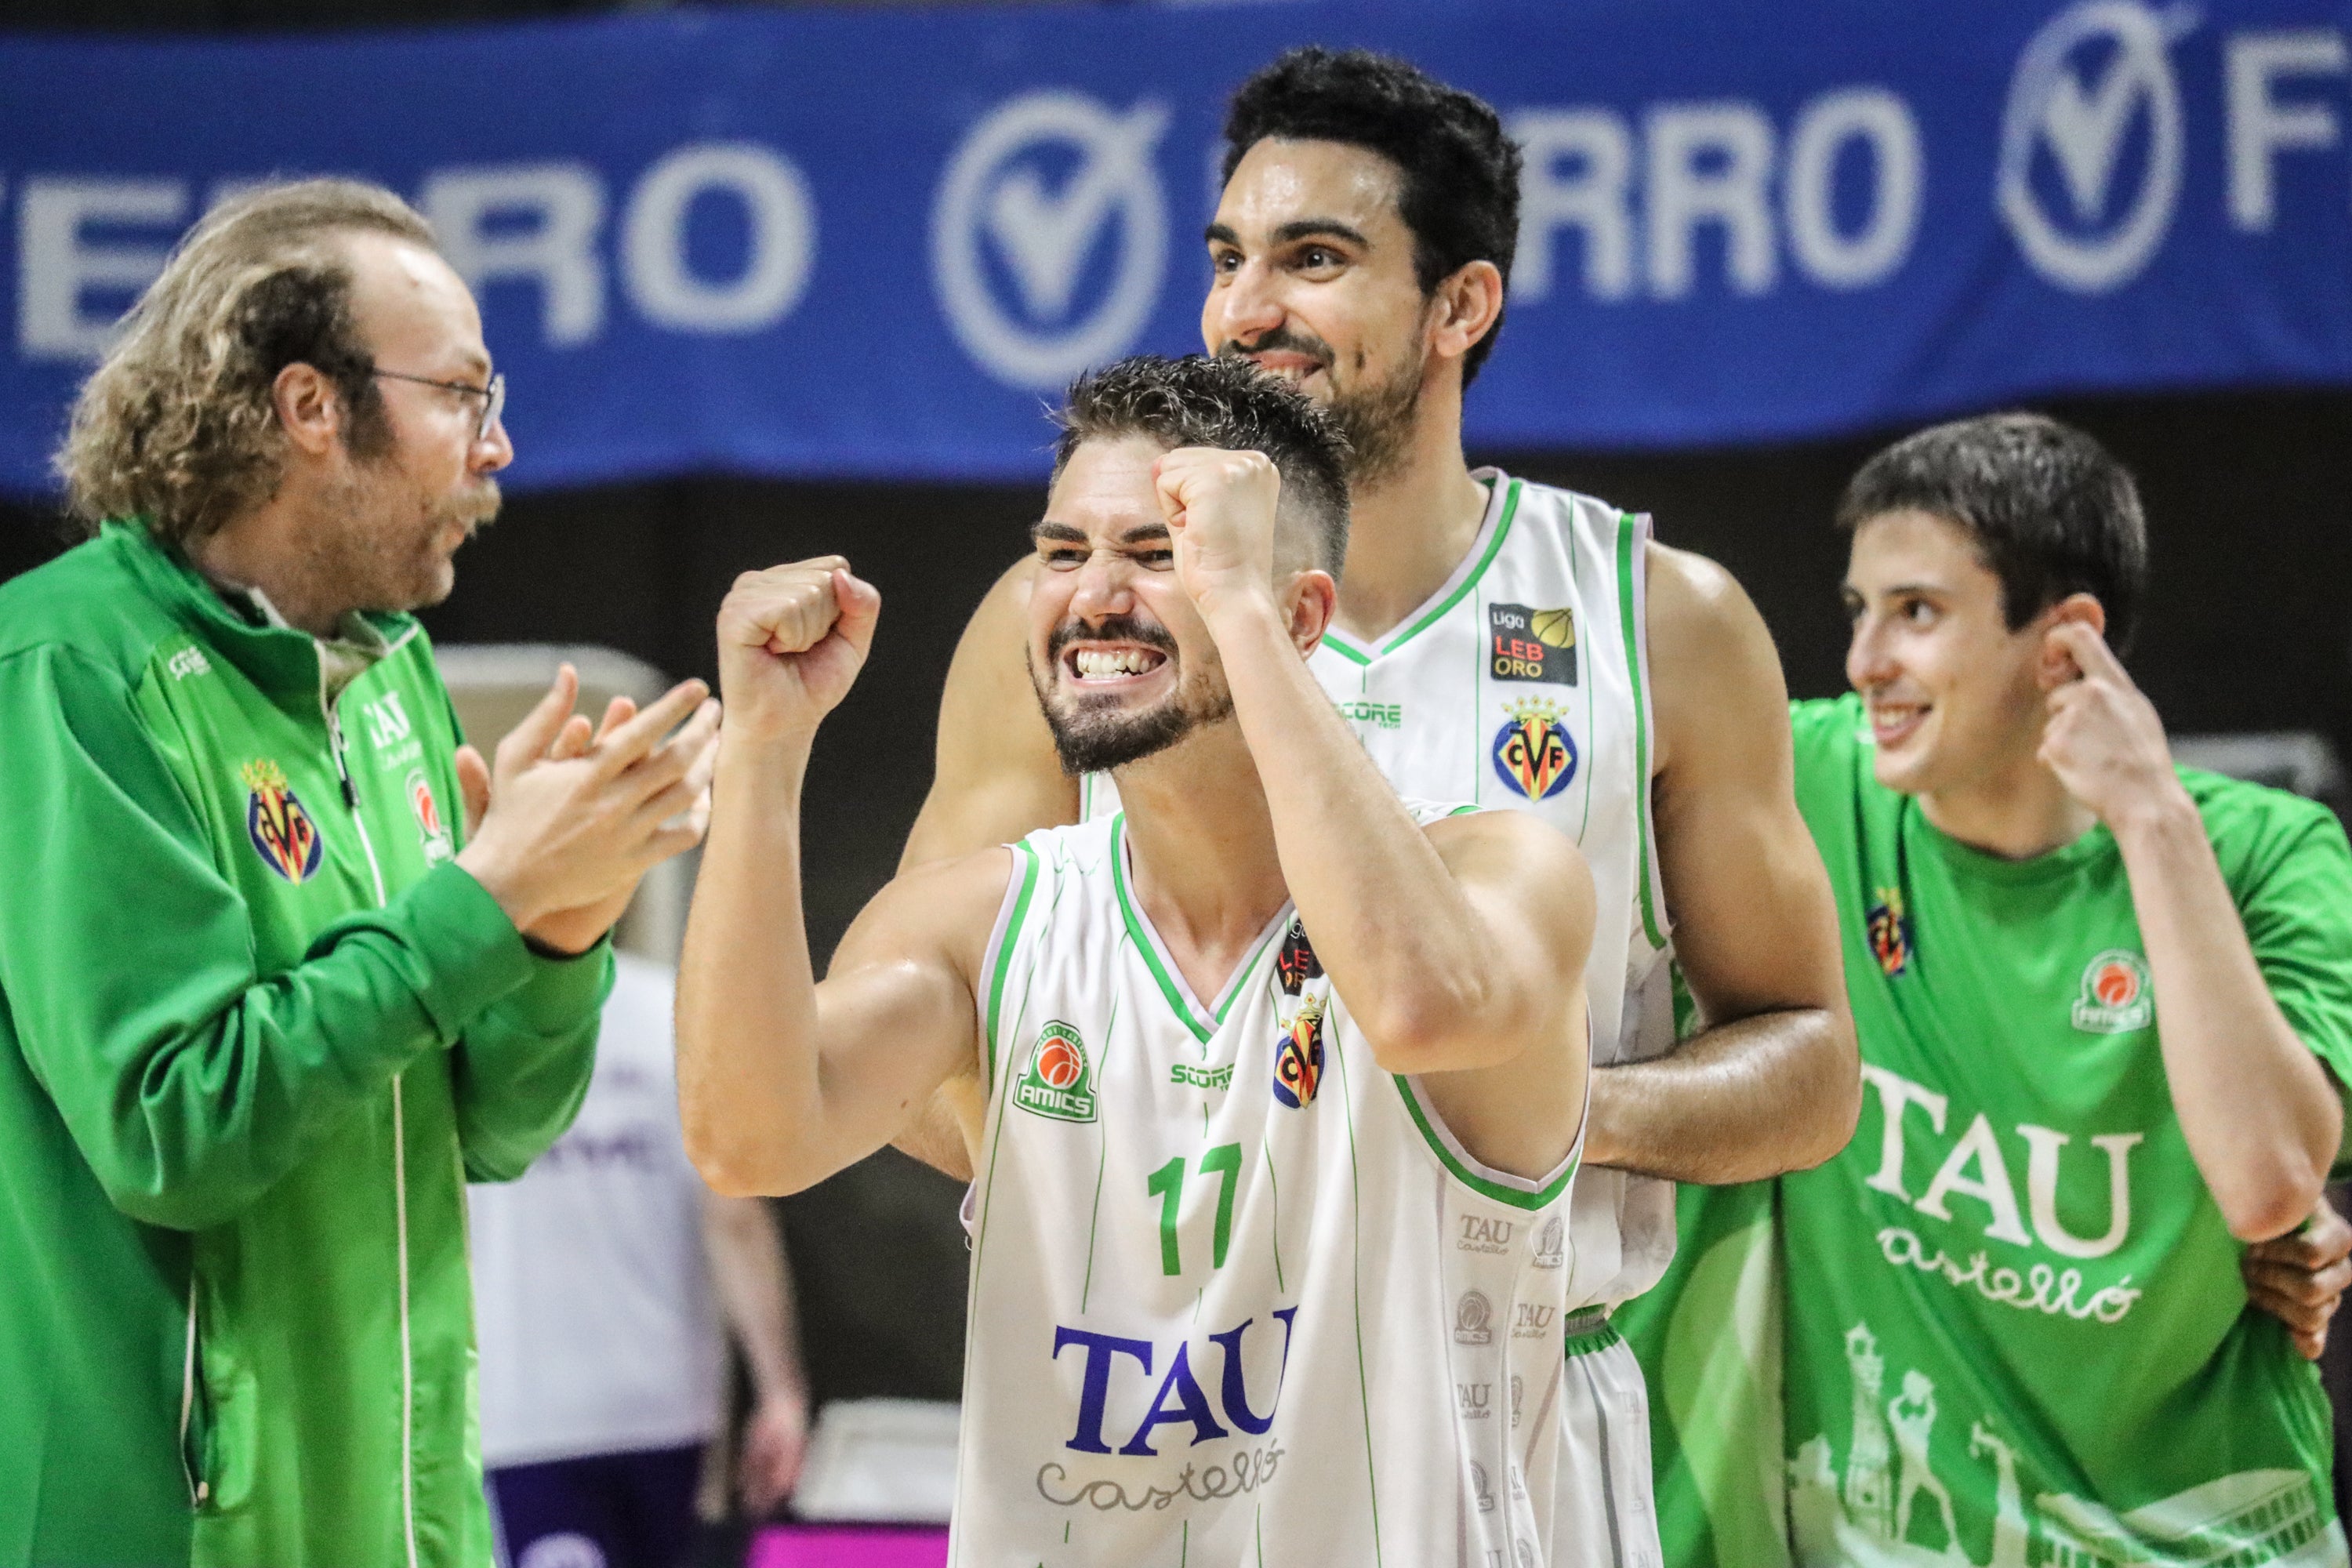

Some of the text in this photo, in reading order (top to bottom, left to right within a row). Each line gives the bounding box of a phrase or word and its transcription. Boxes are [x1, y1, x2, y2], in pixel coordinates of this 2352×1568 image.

[0, 141, 817, 357] ERO
[1494, 610, 1525, 630] Liga
[1495, 635, 1544, 662] LEB
[1495, 656, 1542, 678] ORO
[1334, 702, 1401, 722] CORE
[1507, 728, 1563, 783] CVF
[1279, 949, 1310, 971] LE
[1020, 1084, 1091, 1116] AMICS
[1860, 1059, 2144, 1259] TAU
[1148, 1142, 1243, 1276] 17
[1461, 1214, 1514, 1244] TAU
[1877, 1228, 2142, 1323] astelló
[1515, 1303, 1556, 1328] TAU
[1052, 1305, 1298, 1457] TAU
[1036, 1438, 1285, 1511] Castelló
